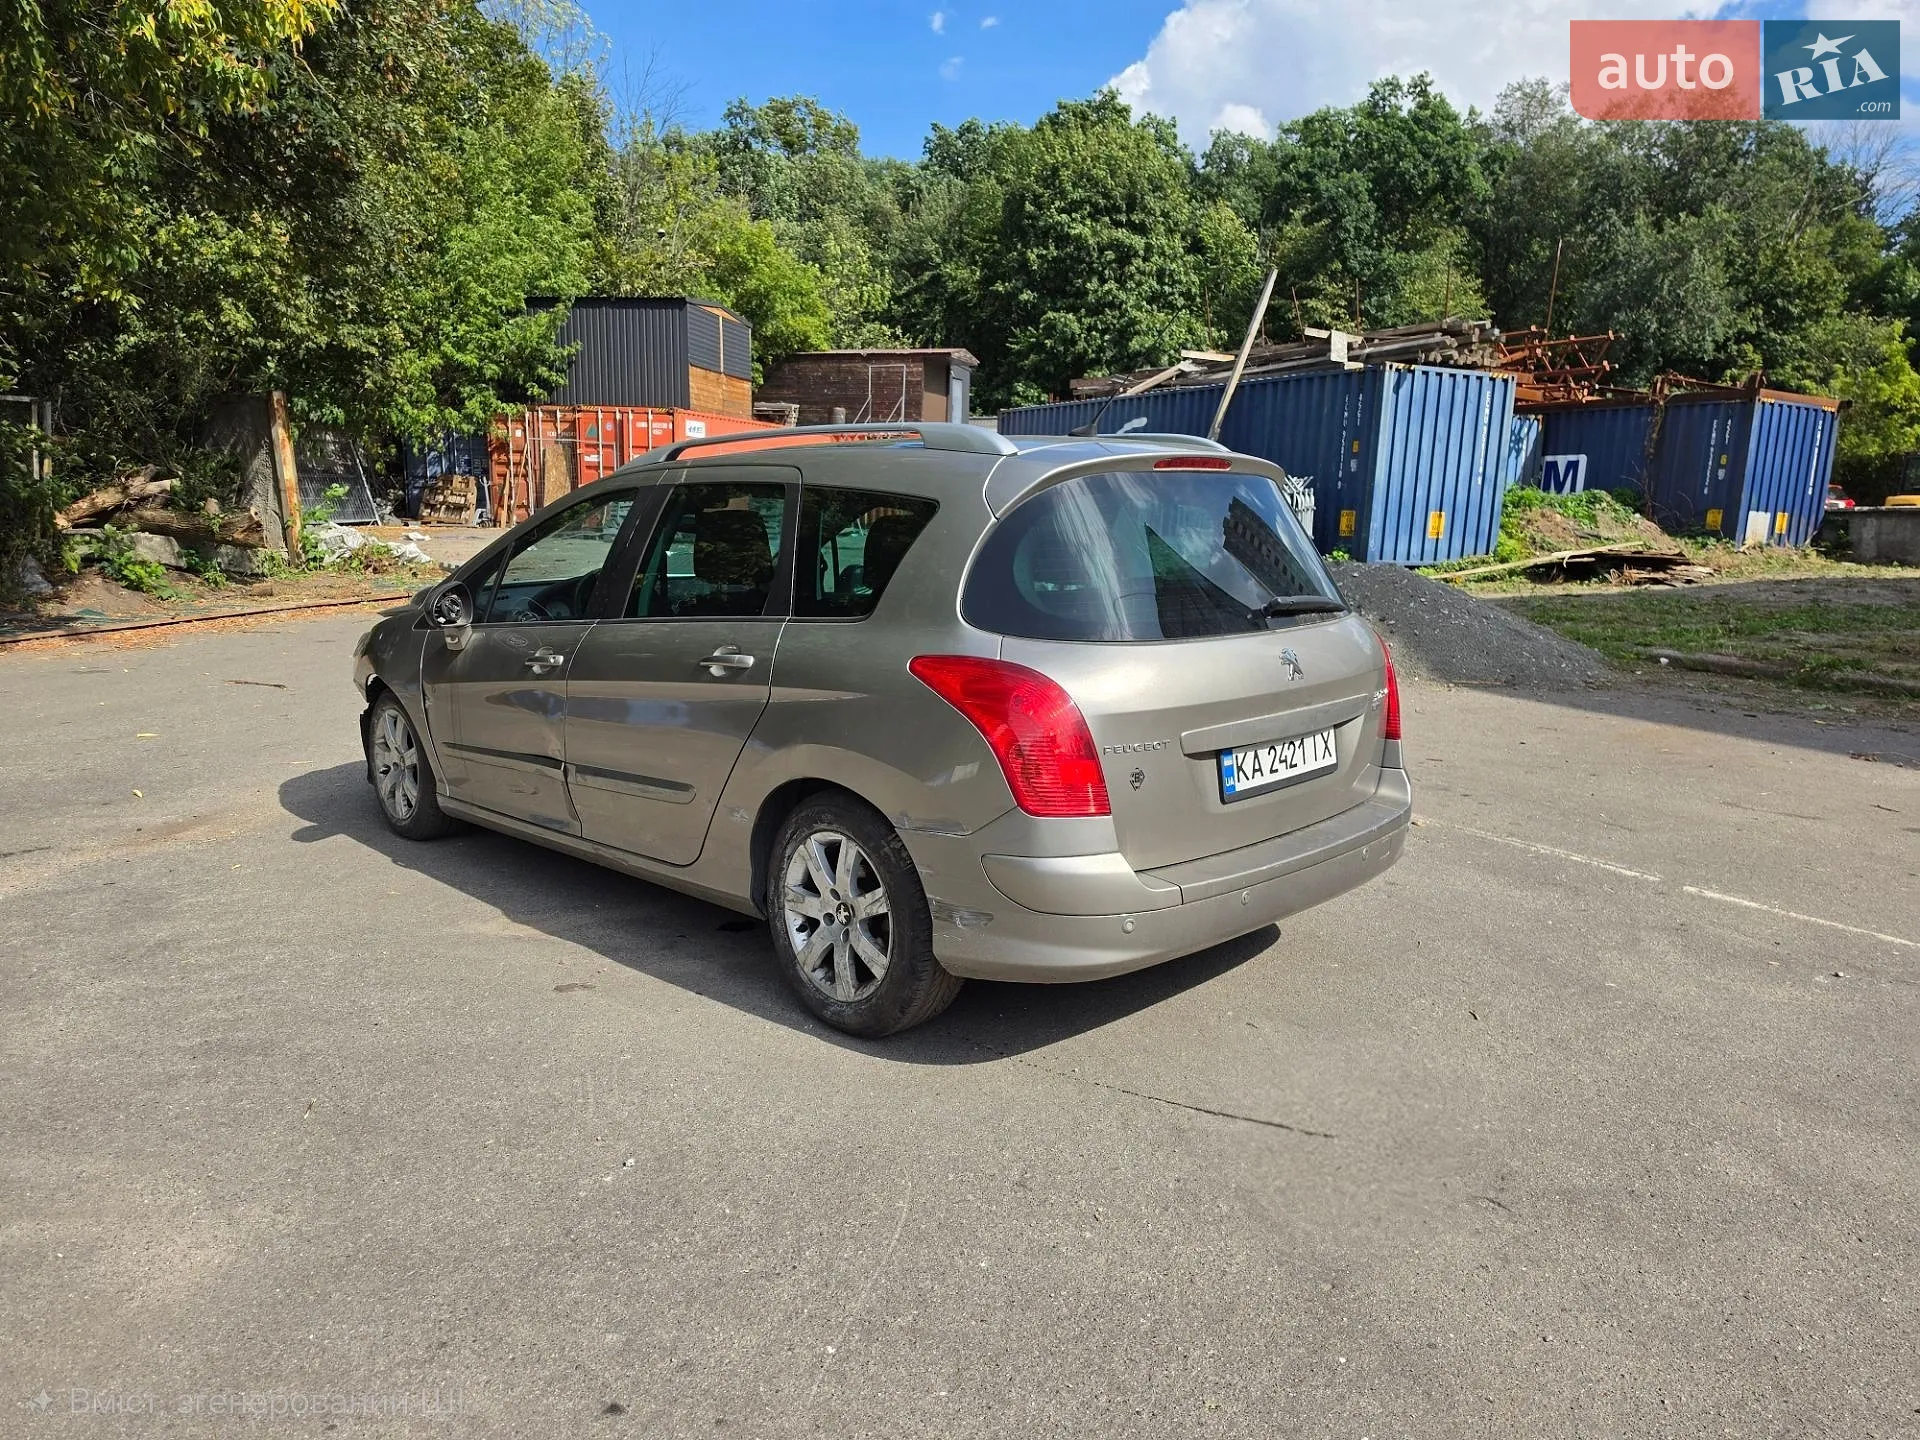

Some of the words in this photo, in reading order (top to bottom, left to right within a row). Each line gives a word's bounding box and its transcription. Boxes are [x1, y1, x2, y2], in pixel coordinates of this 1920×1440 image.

[1541, 460, 1580, 494] M
[1102, 739, 1171, 756] PEUGEOT
[1235, 749, 1264, 784] KA
[1267, 737, 1307, 775] 2421
[1312, 731, 1333, 762] IX
[1224, 776, 1235, 787] UA
